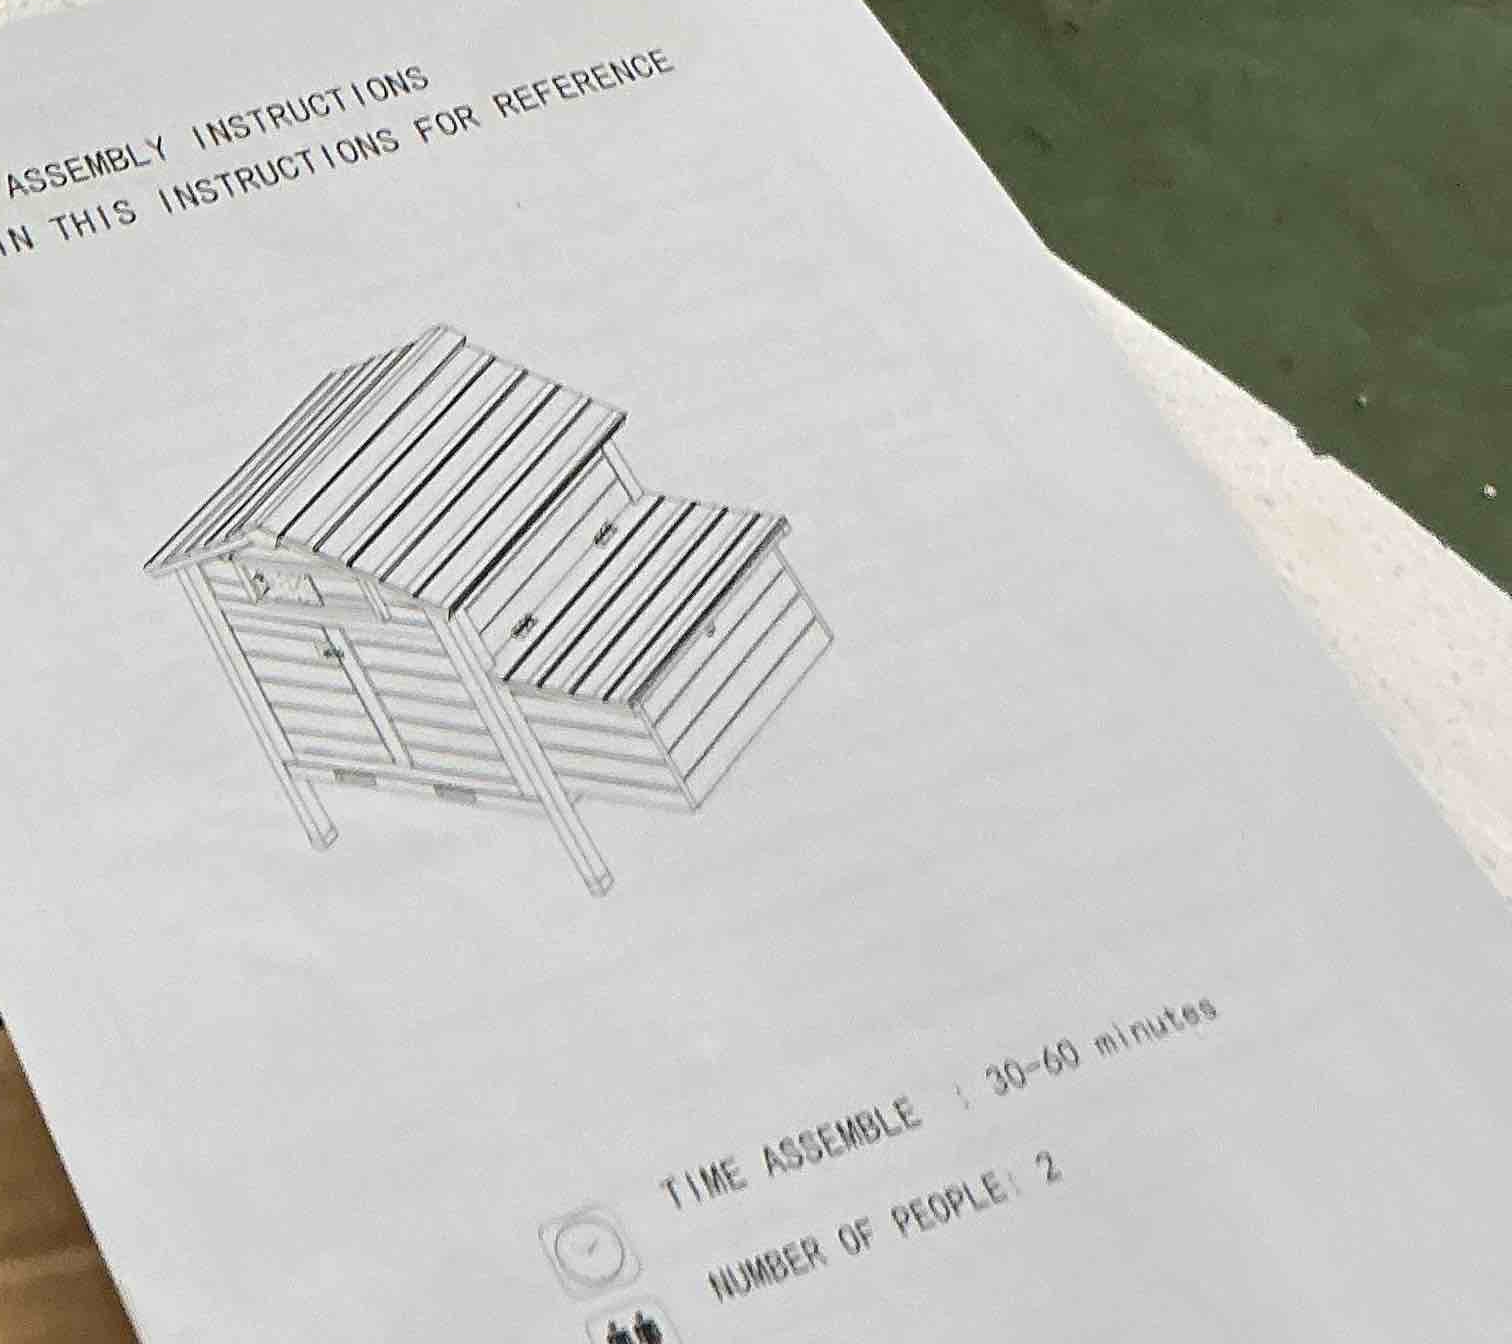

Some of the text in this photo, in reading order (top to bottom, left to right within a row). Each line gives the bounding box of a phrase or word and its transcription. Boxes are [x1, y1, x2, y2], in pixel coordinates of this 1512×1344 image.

[5, 64, 431, 201] ASSEMBLY INSTRUCTIONS
[48, 197, 139, 246] THIS
[158, 127, 402, 216] INSTRUCTIONS
[414, 104, 482, 145] FOR
[493, 47, 676, 120] REFERENCE
[659, 1155, 749, 1212] TIME
[761, 1094, 924, 1179] ASSEMBLE
[983, 1037, 1081, 1098] 30-60
[1092, 994, 1220, 1059] minutes
[707, 1234, 829, 1305] NUMBER
[837, 1216, 875, 1258] OF
[1034, 1149, 1064, 1186] 2
